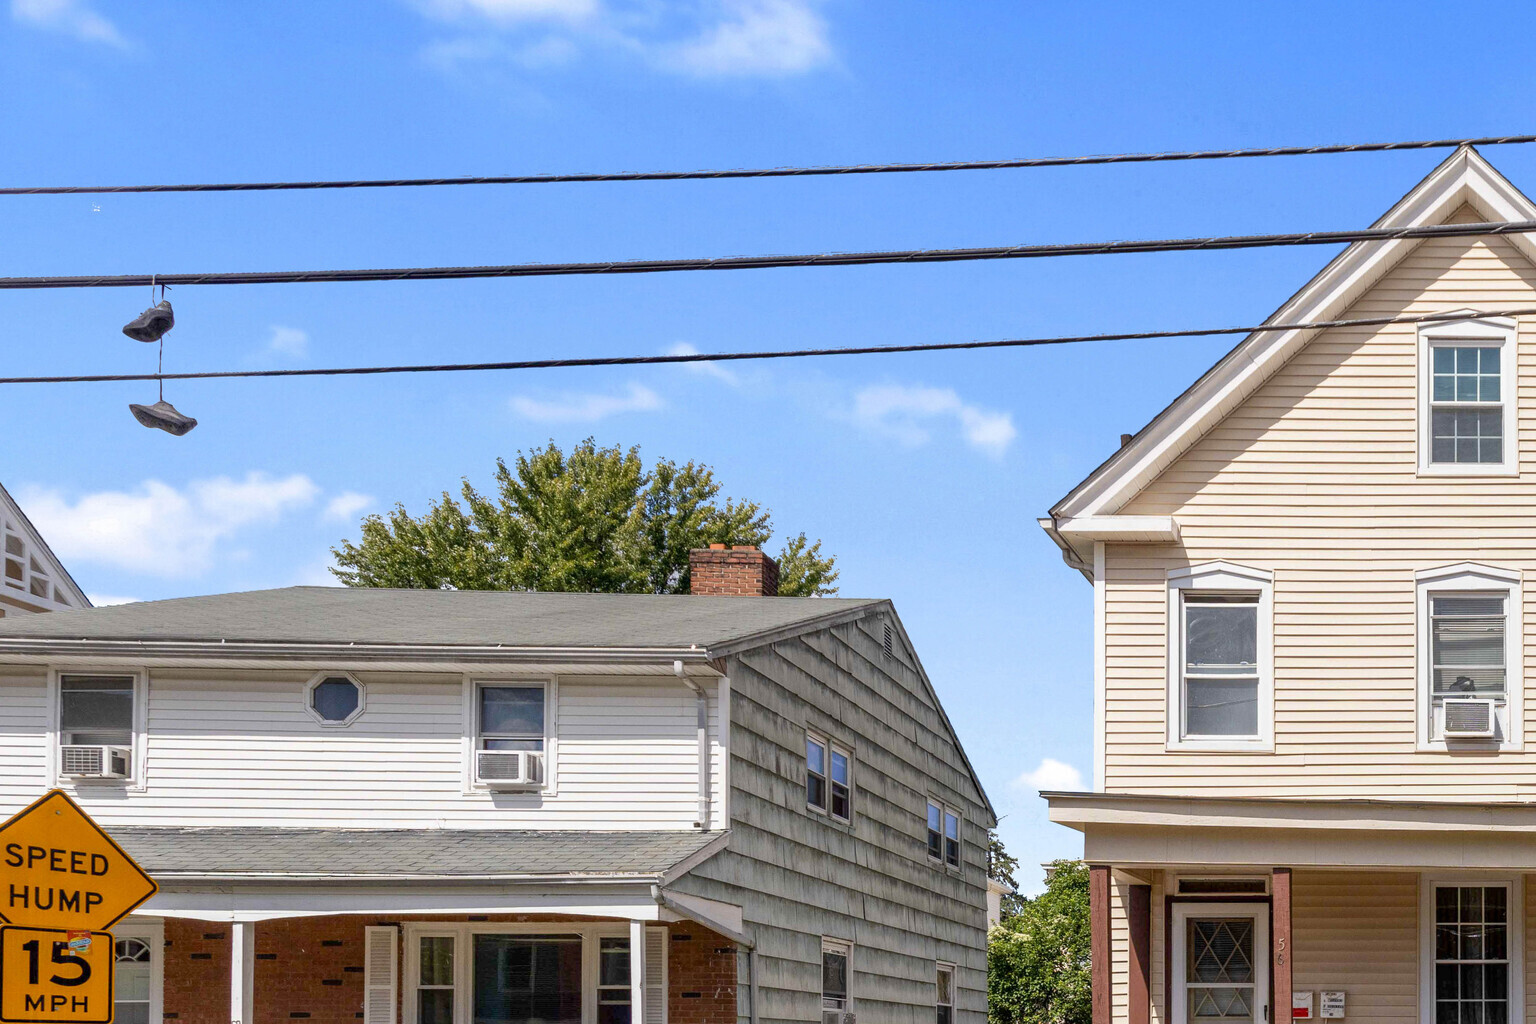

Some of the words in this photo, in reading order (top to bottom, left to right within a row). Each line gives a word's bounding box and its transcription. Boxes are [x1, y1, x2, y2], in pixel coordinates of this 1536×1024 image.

[5, 843, 109, 876] SPEED
[9, 884, 103, 914] HUMP
[23, 939, 91, 986] 15
[25, 994, 88, 1012] MPH
